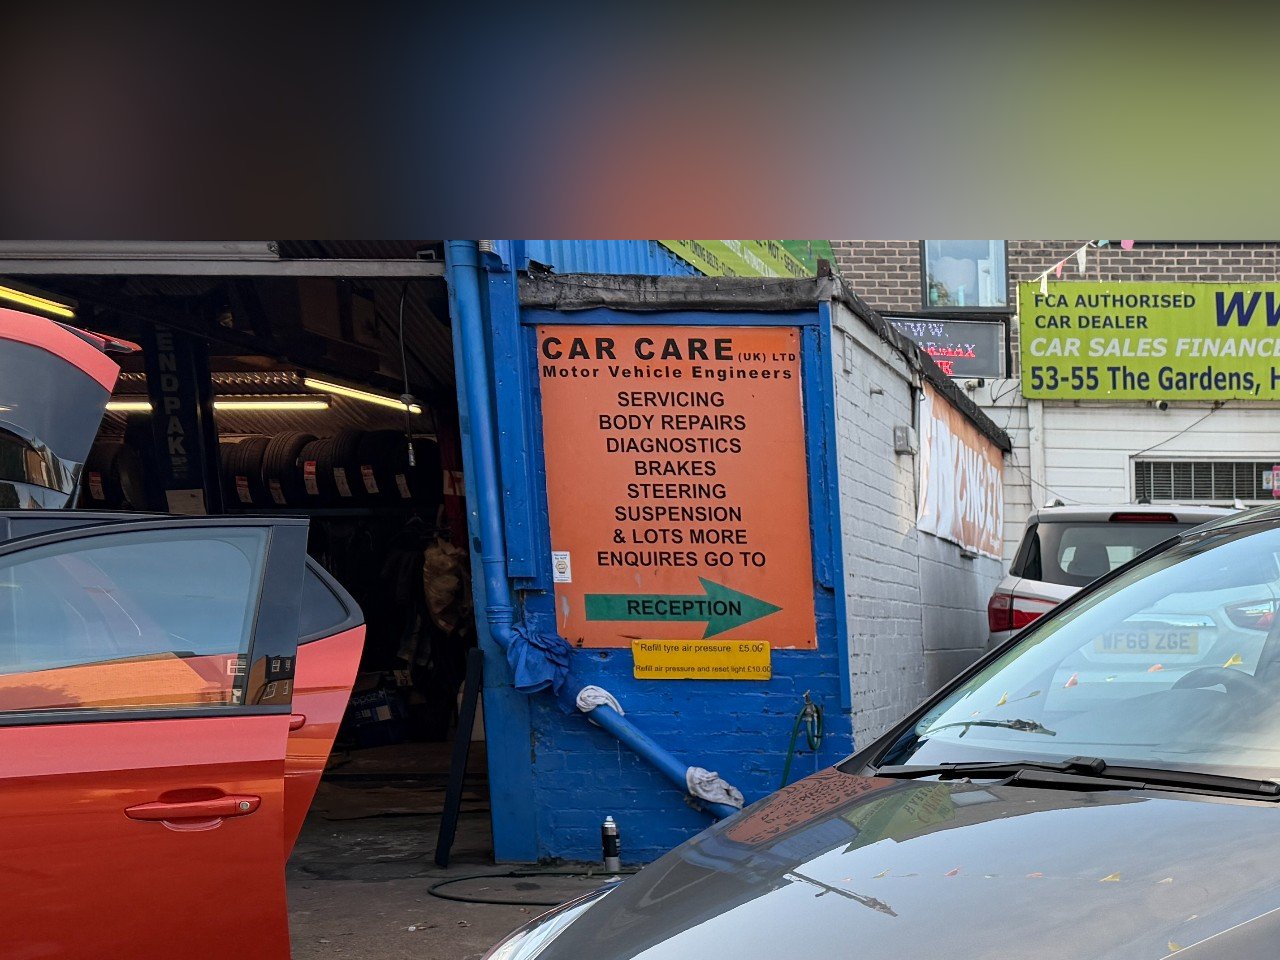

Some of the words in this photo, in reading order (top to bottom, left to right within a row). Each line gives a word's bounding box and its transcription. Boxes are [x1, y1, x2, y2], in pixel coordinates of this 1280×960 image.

[1034, 294, 1071, 308] FCA
[1075, 294, 1196, 308] AUTHORISED
[1035, 315, 1075, 329] CAR
[1081, 315, 1148, 329] DEALER
[542, 337, 616, 360] CAR
[635, 338, 733, 360] CARE
[738, 353, 766, 362] (UK)
[772, 353, 796, 361] LTD
[1030, 337, 1082, 357] CAR
[1088, 338, 1167, 357] SALES
[543, 366, 599, 377] Motor
[608, 366, 682, 378] Vehicle
[692, 366, 792, 381] Engineers
[1031, 366, 1099, 391] 53-55
[1107, 366, 1149, 391] The
[1160, 365, 1261, 396] Gardens,
[617, 391, 725, 407] SERVICING
[599, 414, 654, 430] BODY
[661, 414, 746, 430] REPAIRS
[606, 438, 742, 453] DIAGNOSTICS
[634, 460, 716, 476] BRAKES
[627, 483, 727, 499] STEERING
[614, 506, 742, 522] SUSPENSION
[613, 529, 626, 544] &
[632, 528, 684, 545] LOTS
[690, 529, 747, 545] MORE
[597, 551, 698, 567] ENQUIRES
[704, 552, 735, 567] GO
[740, 552, 766, 567] TO
[627, 600, 742, 616] RECEPTION
[640, 643, 661, 652] Refill
[663, 644, 679, 654] tyre
[682, 643, 692, 652] air
[694, 645, 732, 654] pressure
[665, 666, 695, 674] pressure
[697, 665, 710, 673] and
